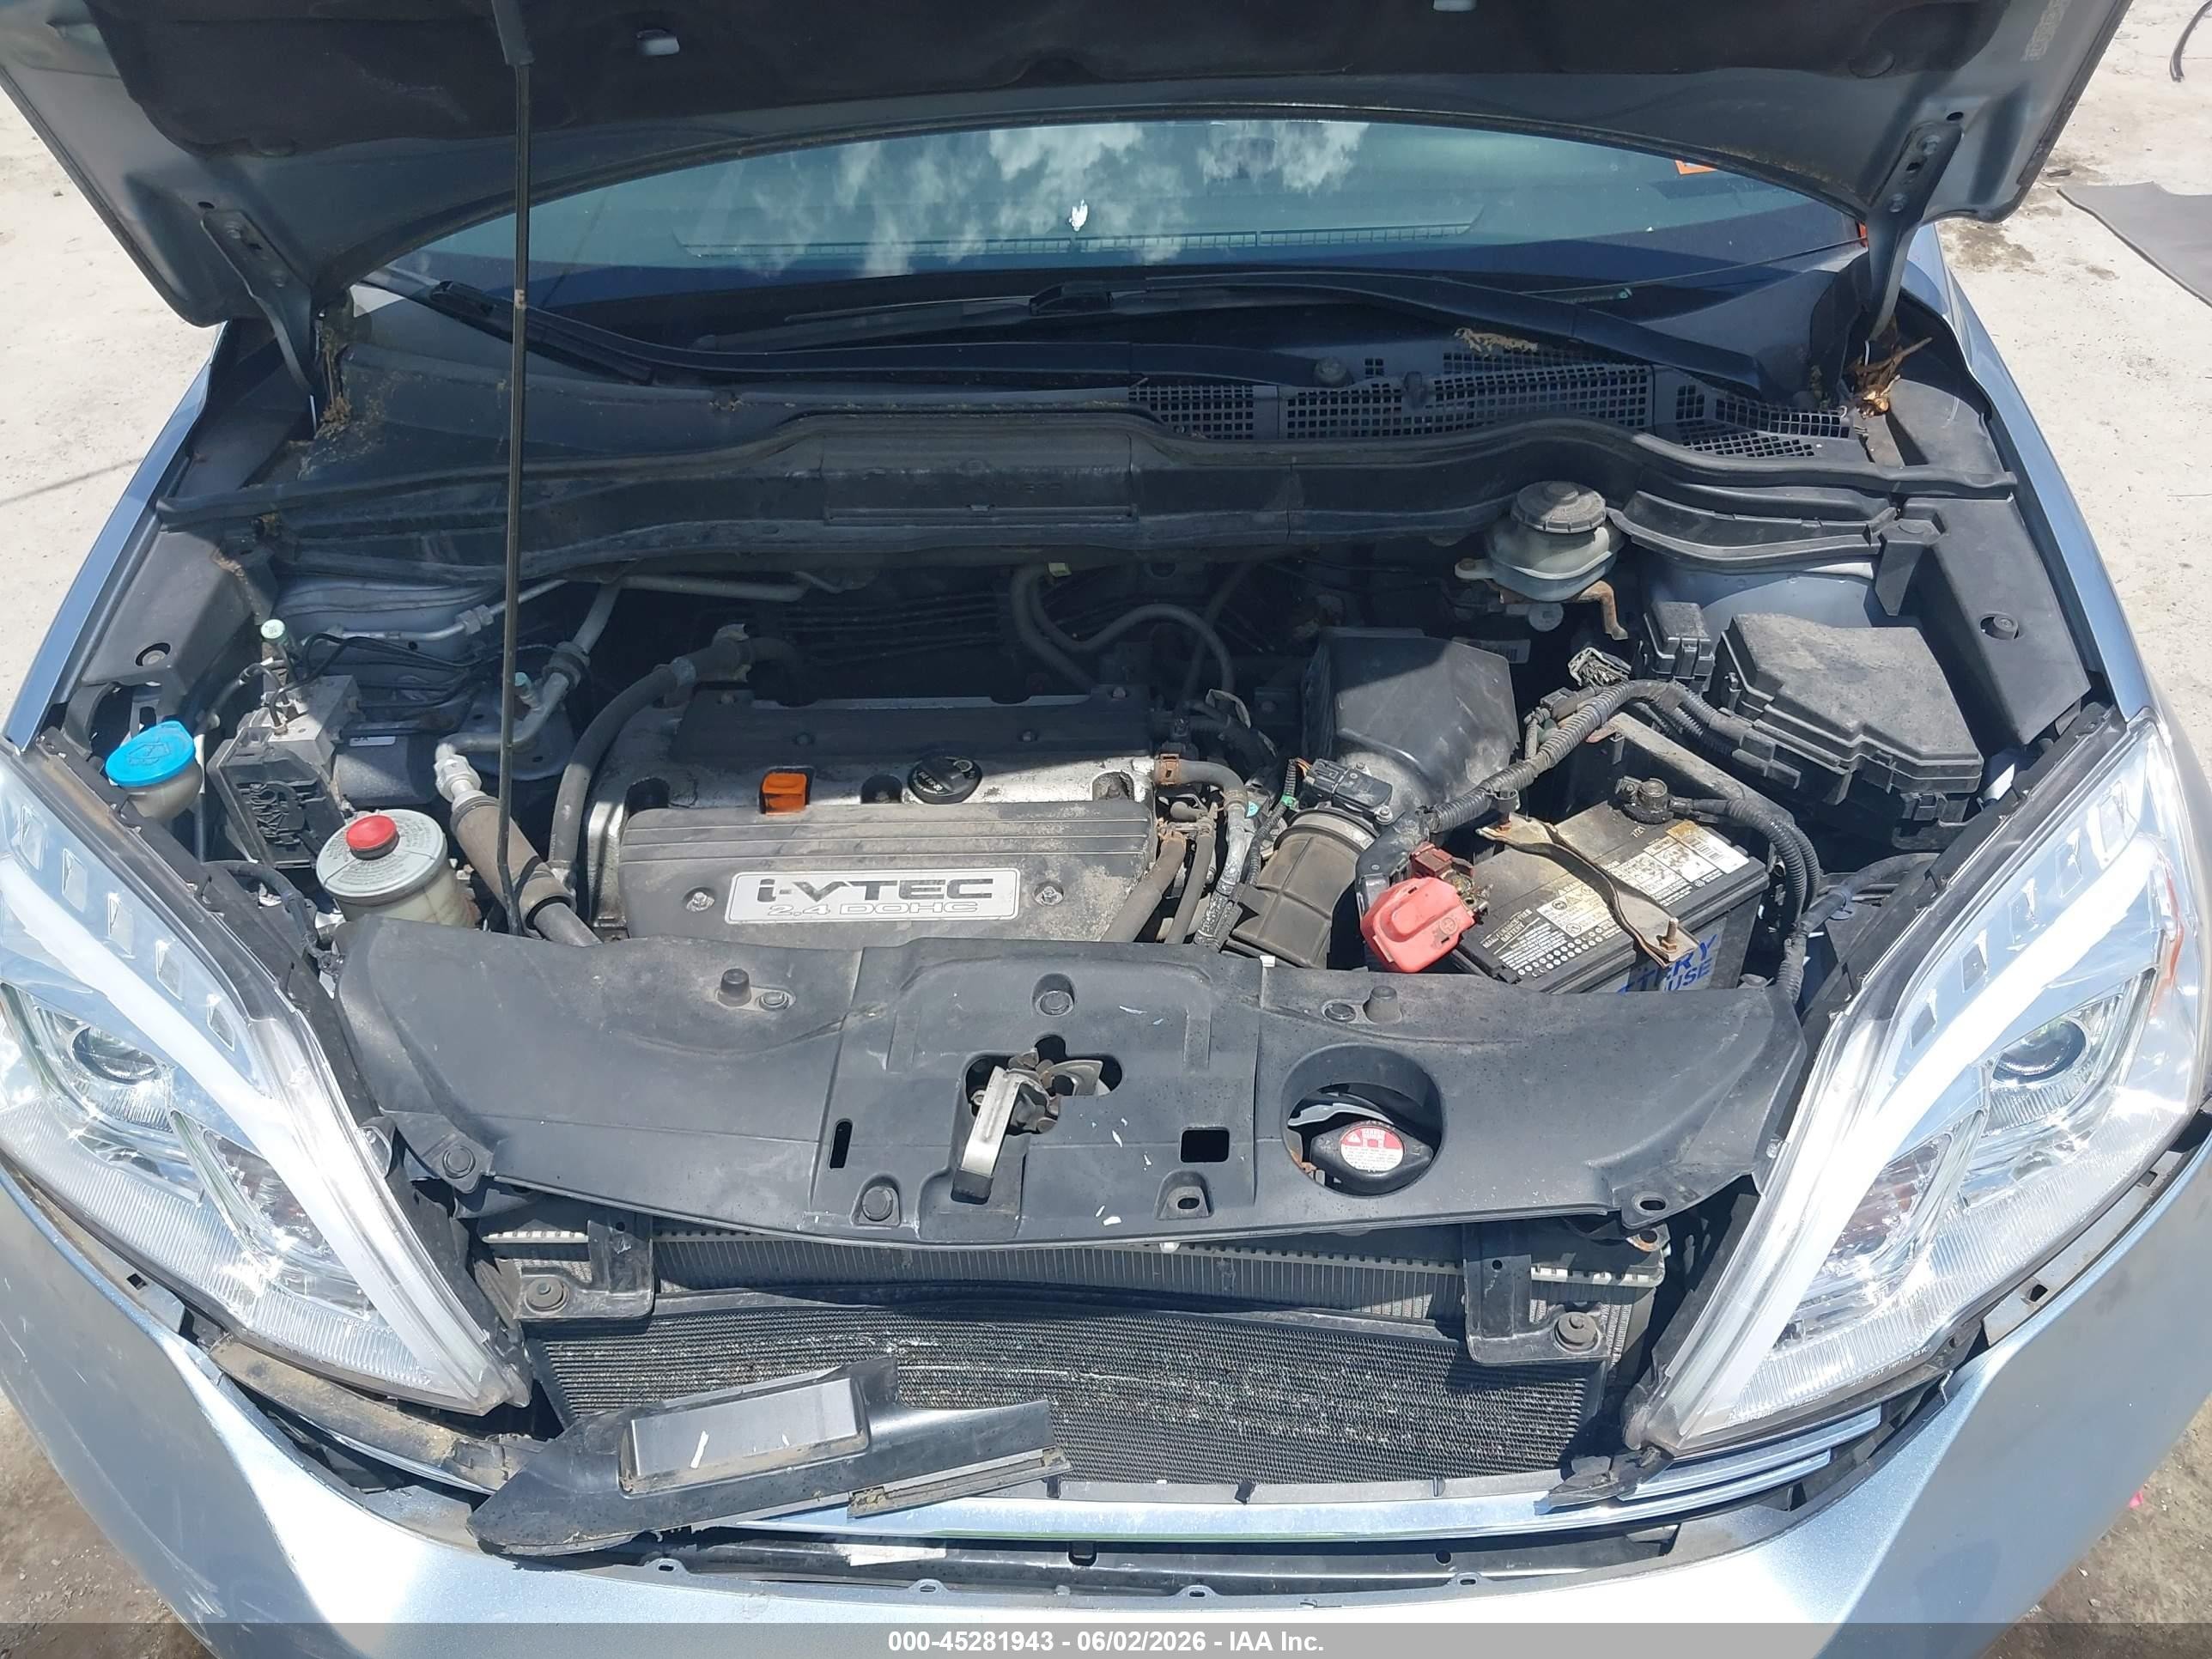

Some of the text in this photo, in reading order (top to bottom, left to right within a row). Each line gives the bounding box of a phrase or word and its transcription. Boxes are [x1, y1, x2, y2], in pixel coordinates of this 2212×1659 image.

[757, 878, 994, 903] i-VTEC
[768, 901, 978, 916] 2.4 DOHC
[1665, 957, 1712, 991] USE
